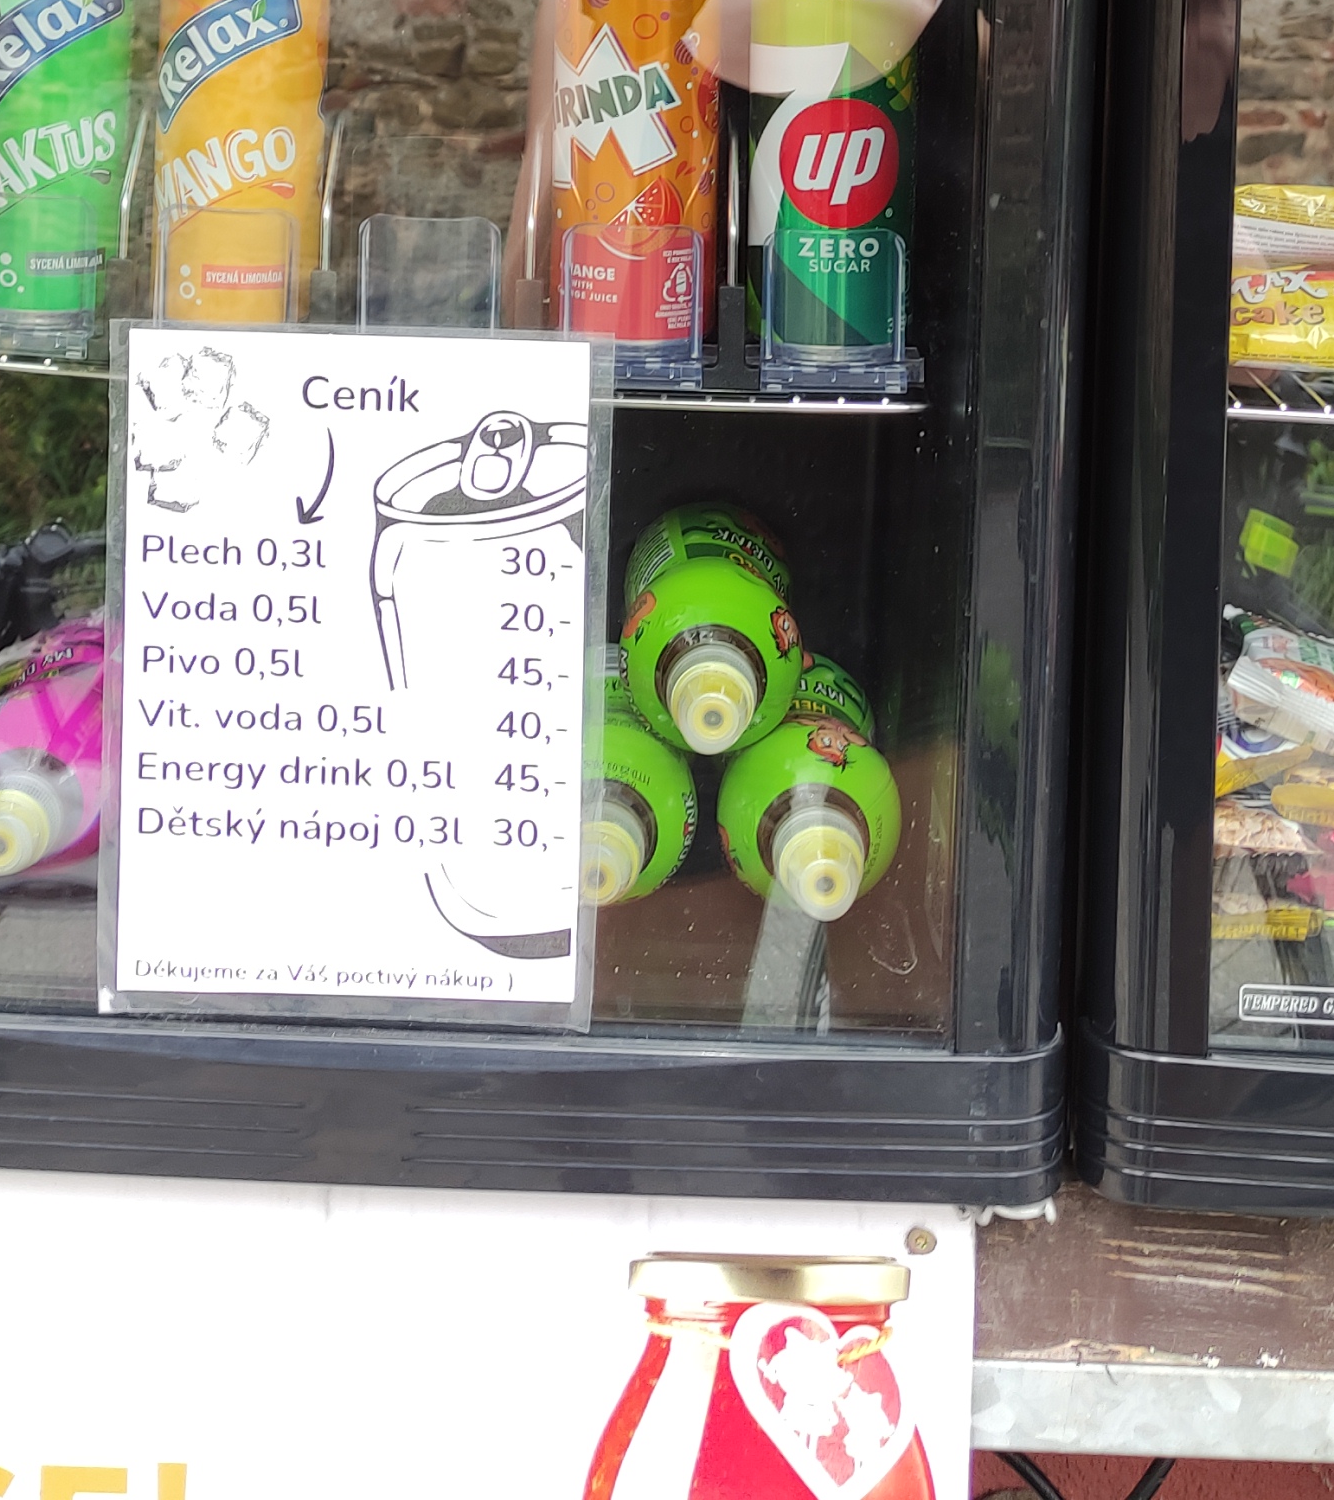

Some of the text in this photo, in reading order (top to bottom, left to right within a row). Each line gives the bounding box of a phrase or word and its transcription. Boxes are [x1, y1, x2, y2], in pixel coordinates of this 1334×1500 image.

[158, 8, 275, 110] Relax
[154, 125, 296, 228] MANGO
[29, 255, 65, 271] SYCENÁ
[798, 237, 880, 259] ZERO
[808, 258, 871, 274] SUGAR
[205, 269, 239, 283] SYCENÁ
[589, 292, 618, 303] JUICE
[1231, 301, 1325, 326] cake
[302, 375, 420, 413] Ceník
[142, 534, 573, 581] Plech 0,3l 30,-
[711, 528, 773, 568] DRINK
[141, 590, 571, 637] Voda 0,5l 20,-
[143, 645, 569, 691] Pivo 0,5l 45,-
[138, 699, 567, 745] Vit. voda 0,5l 40,-
[138, 752, 566, 797] Energy drink 0,5l 45,-
[138, 806, 564, 852] Dětský nápoj 0,3l 30,-
[425, 968, 493, 992] nákup
[1242, 992, 1319, 1013] TEMPERED
